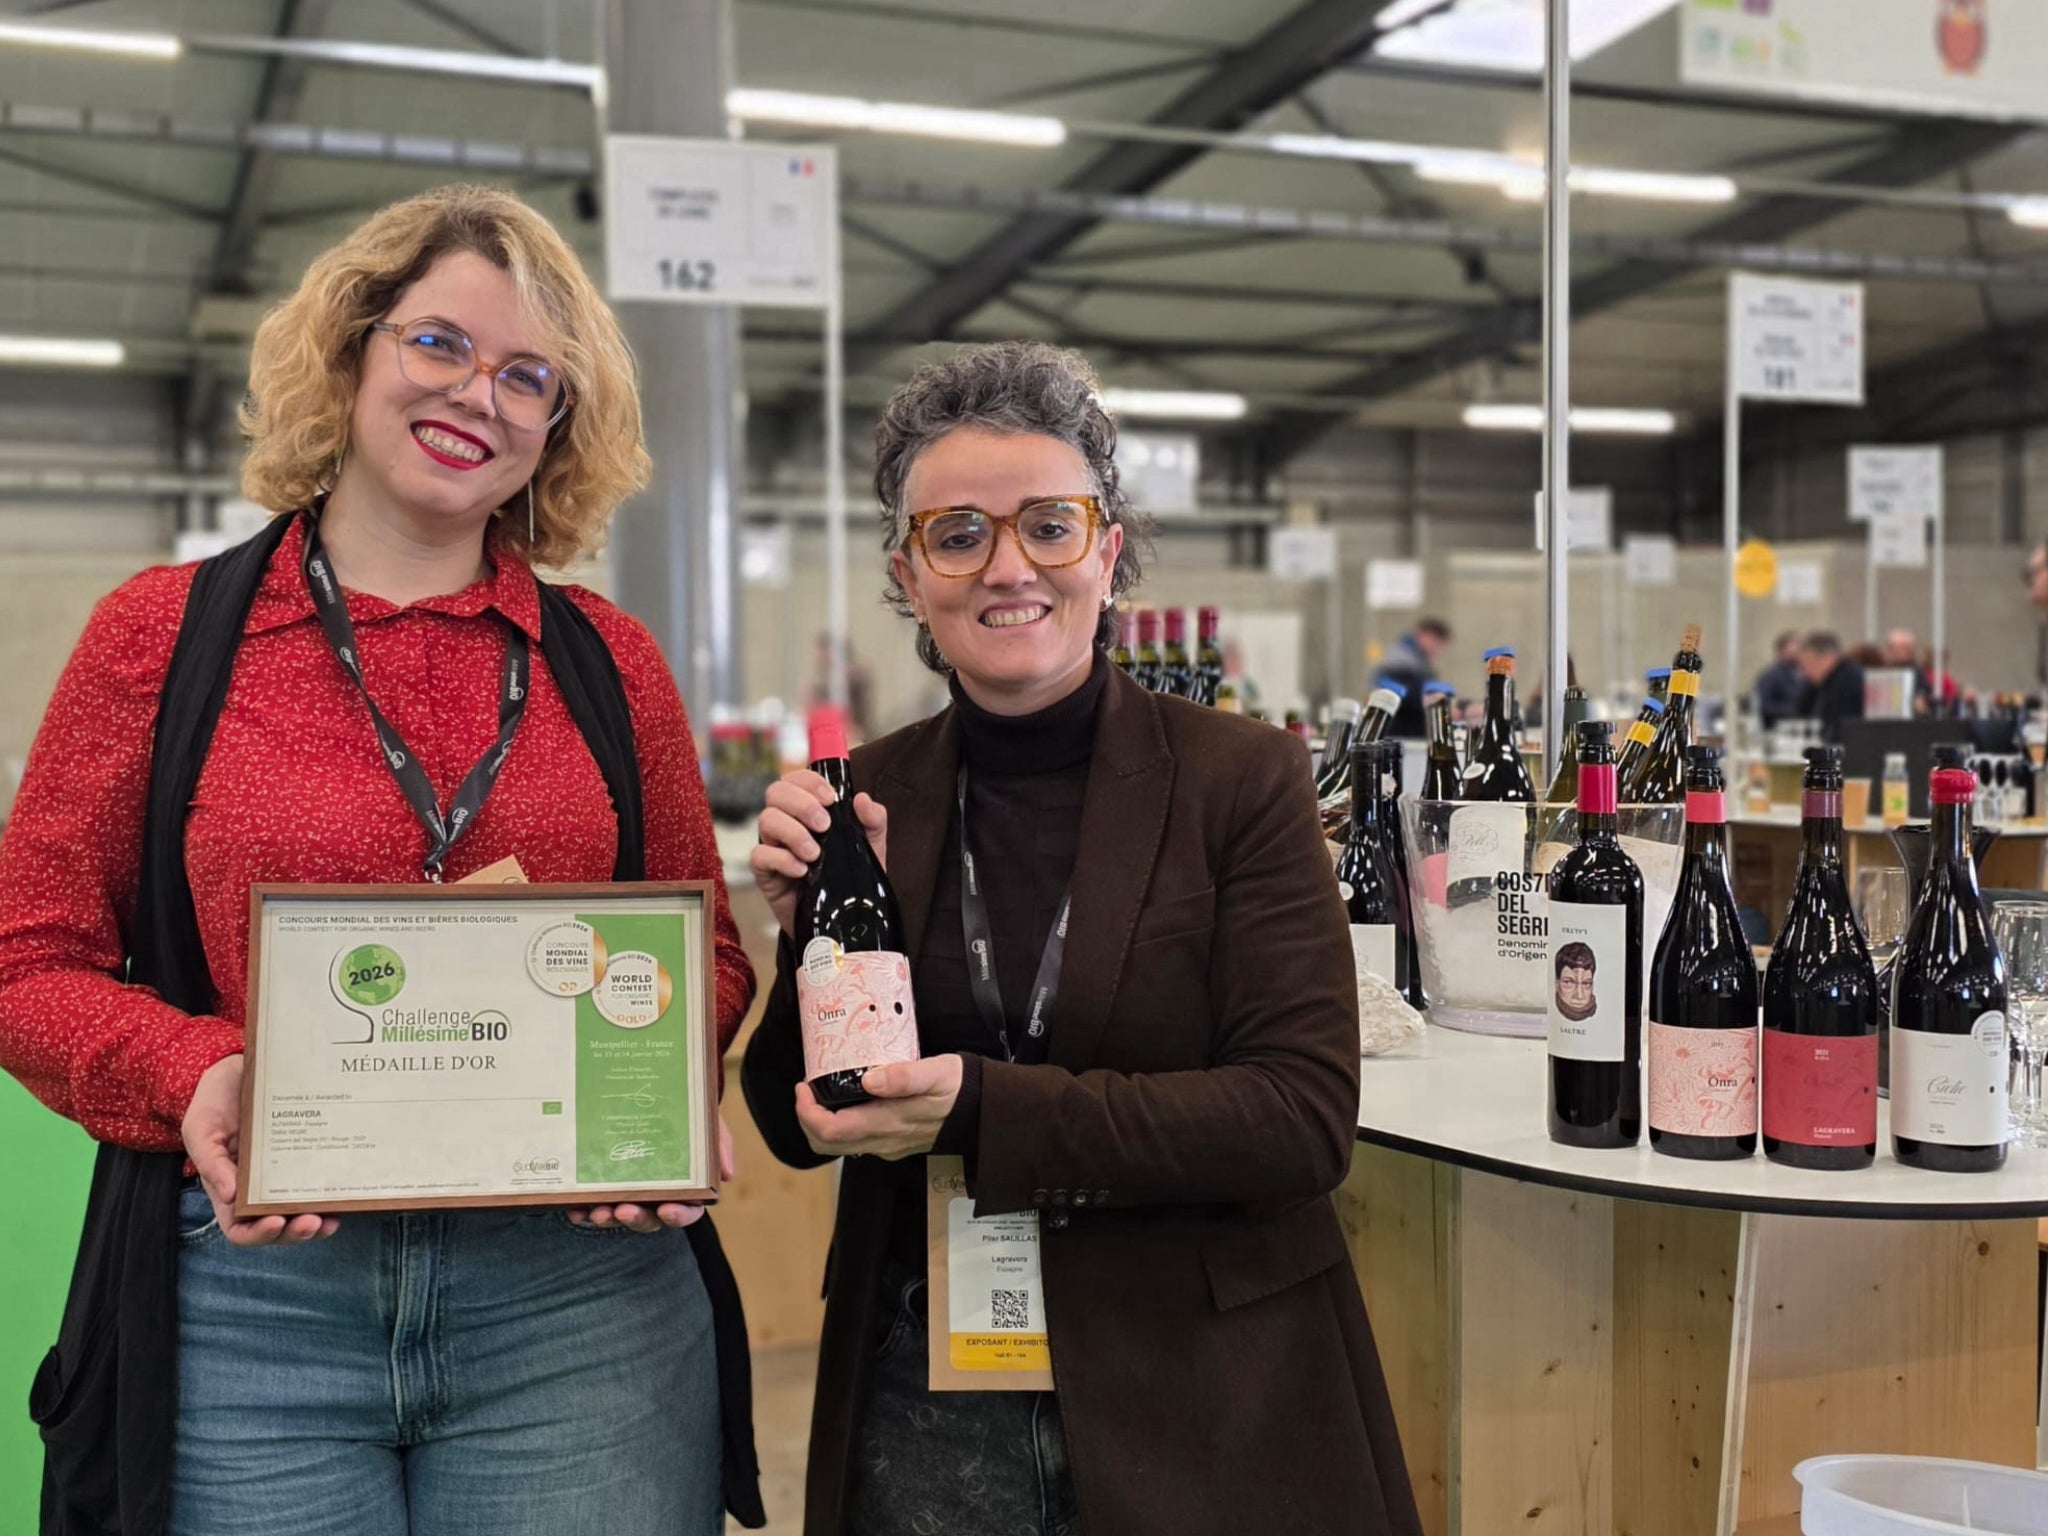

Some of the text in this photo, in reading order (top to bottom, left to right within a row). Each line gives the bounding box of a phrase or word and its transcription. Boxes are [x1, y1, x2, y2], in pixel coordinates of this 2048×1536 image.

[657, 260, 716, 291] 162
[1497, 892, 1530, 914] DEL
[278, 916, 329, 924] CONCOURS
[330, 916, 372, 924] MONDIAL
[373, 916, 390, 924] DES
[392, 915, 414, 924] VINS
[415, 915, 426, 923] ET
[460, 915, 519, 924] BIOLOGIQUES
[545, 949, 589, 957] MONDIAL
[545, 958, 589, 966] DES VINS
[347, 961, 396, 987] 2026
[610, 974, 653, 984] WORLD
[610, 984, 653, 993] CONTEST
[381, 1008, 471, 1031] Challenge
[617, 1014, 646, 1024] GOLD
[589, 1040, 638, 1050] Montpellier
[645, 1039, 674, 1049] France
[341, 1054, 497, 1073] MÉDAILLE D'OR
[271, 1110, 322, 1119] LAGRAVERA
[1813, 1127, 1856, 1135] LAGRAVERA
[991, 1256, 1028, 1264] Lagravera
[966, 1338, 1008, 1346] EXPOSANT
